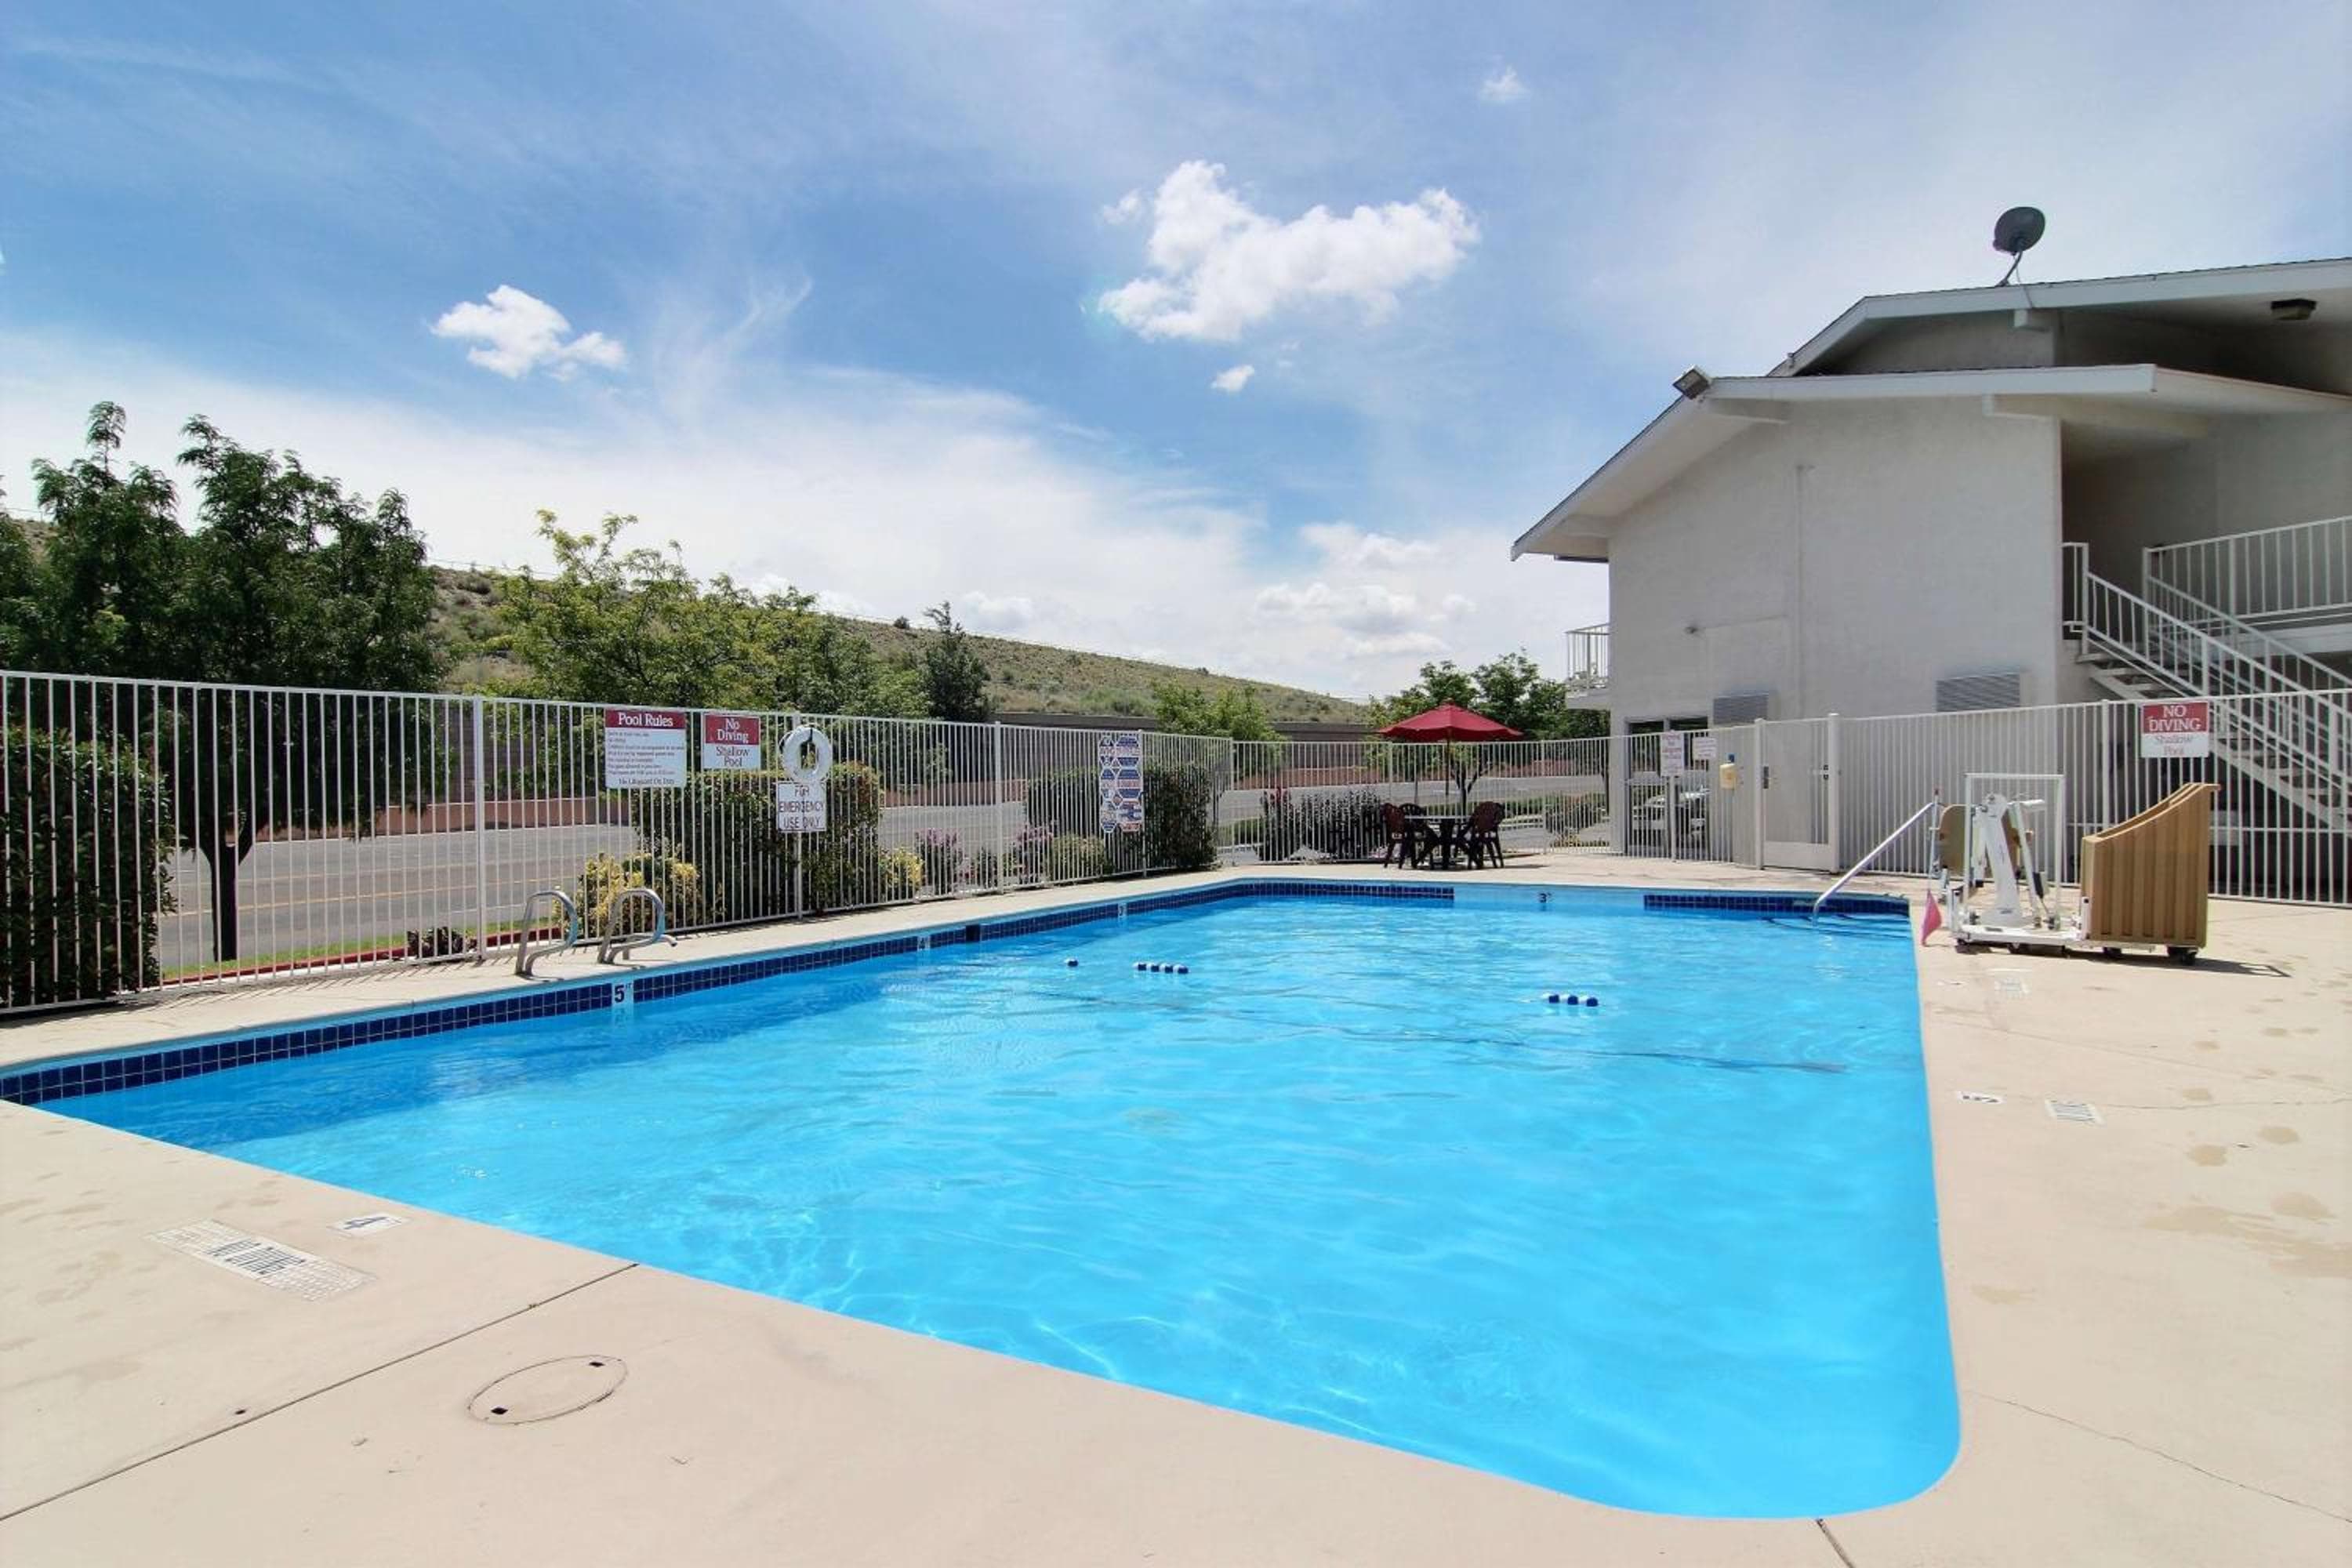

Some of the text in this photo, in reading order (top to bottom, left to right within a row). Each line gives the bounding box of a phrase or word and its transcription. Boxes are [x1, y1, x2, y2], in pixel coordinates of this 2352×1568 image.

[2162, 705, 2187, 717] NO
[617, 712, 673, 727] Pool Rules
[725, 718, 740, 730] No
[2149, 717, 2202, 731] DIVING
[717, 728, 750, 744] Diving
[724, 756, 742, 767] Pool
[784, 816, 800, 829] USE
[614, 984, 625, 1003] 5
